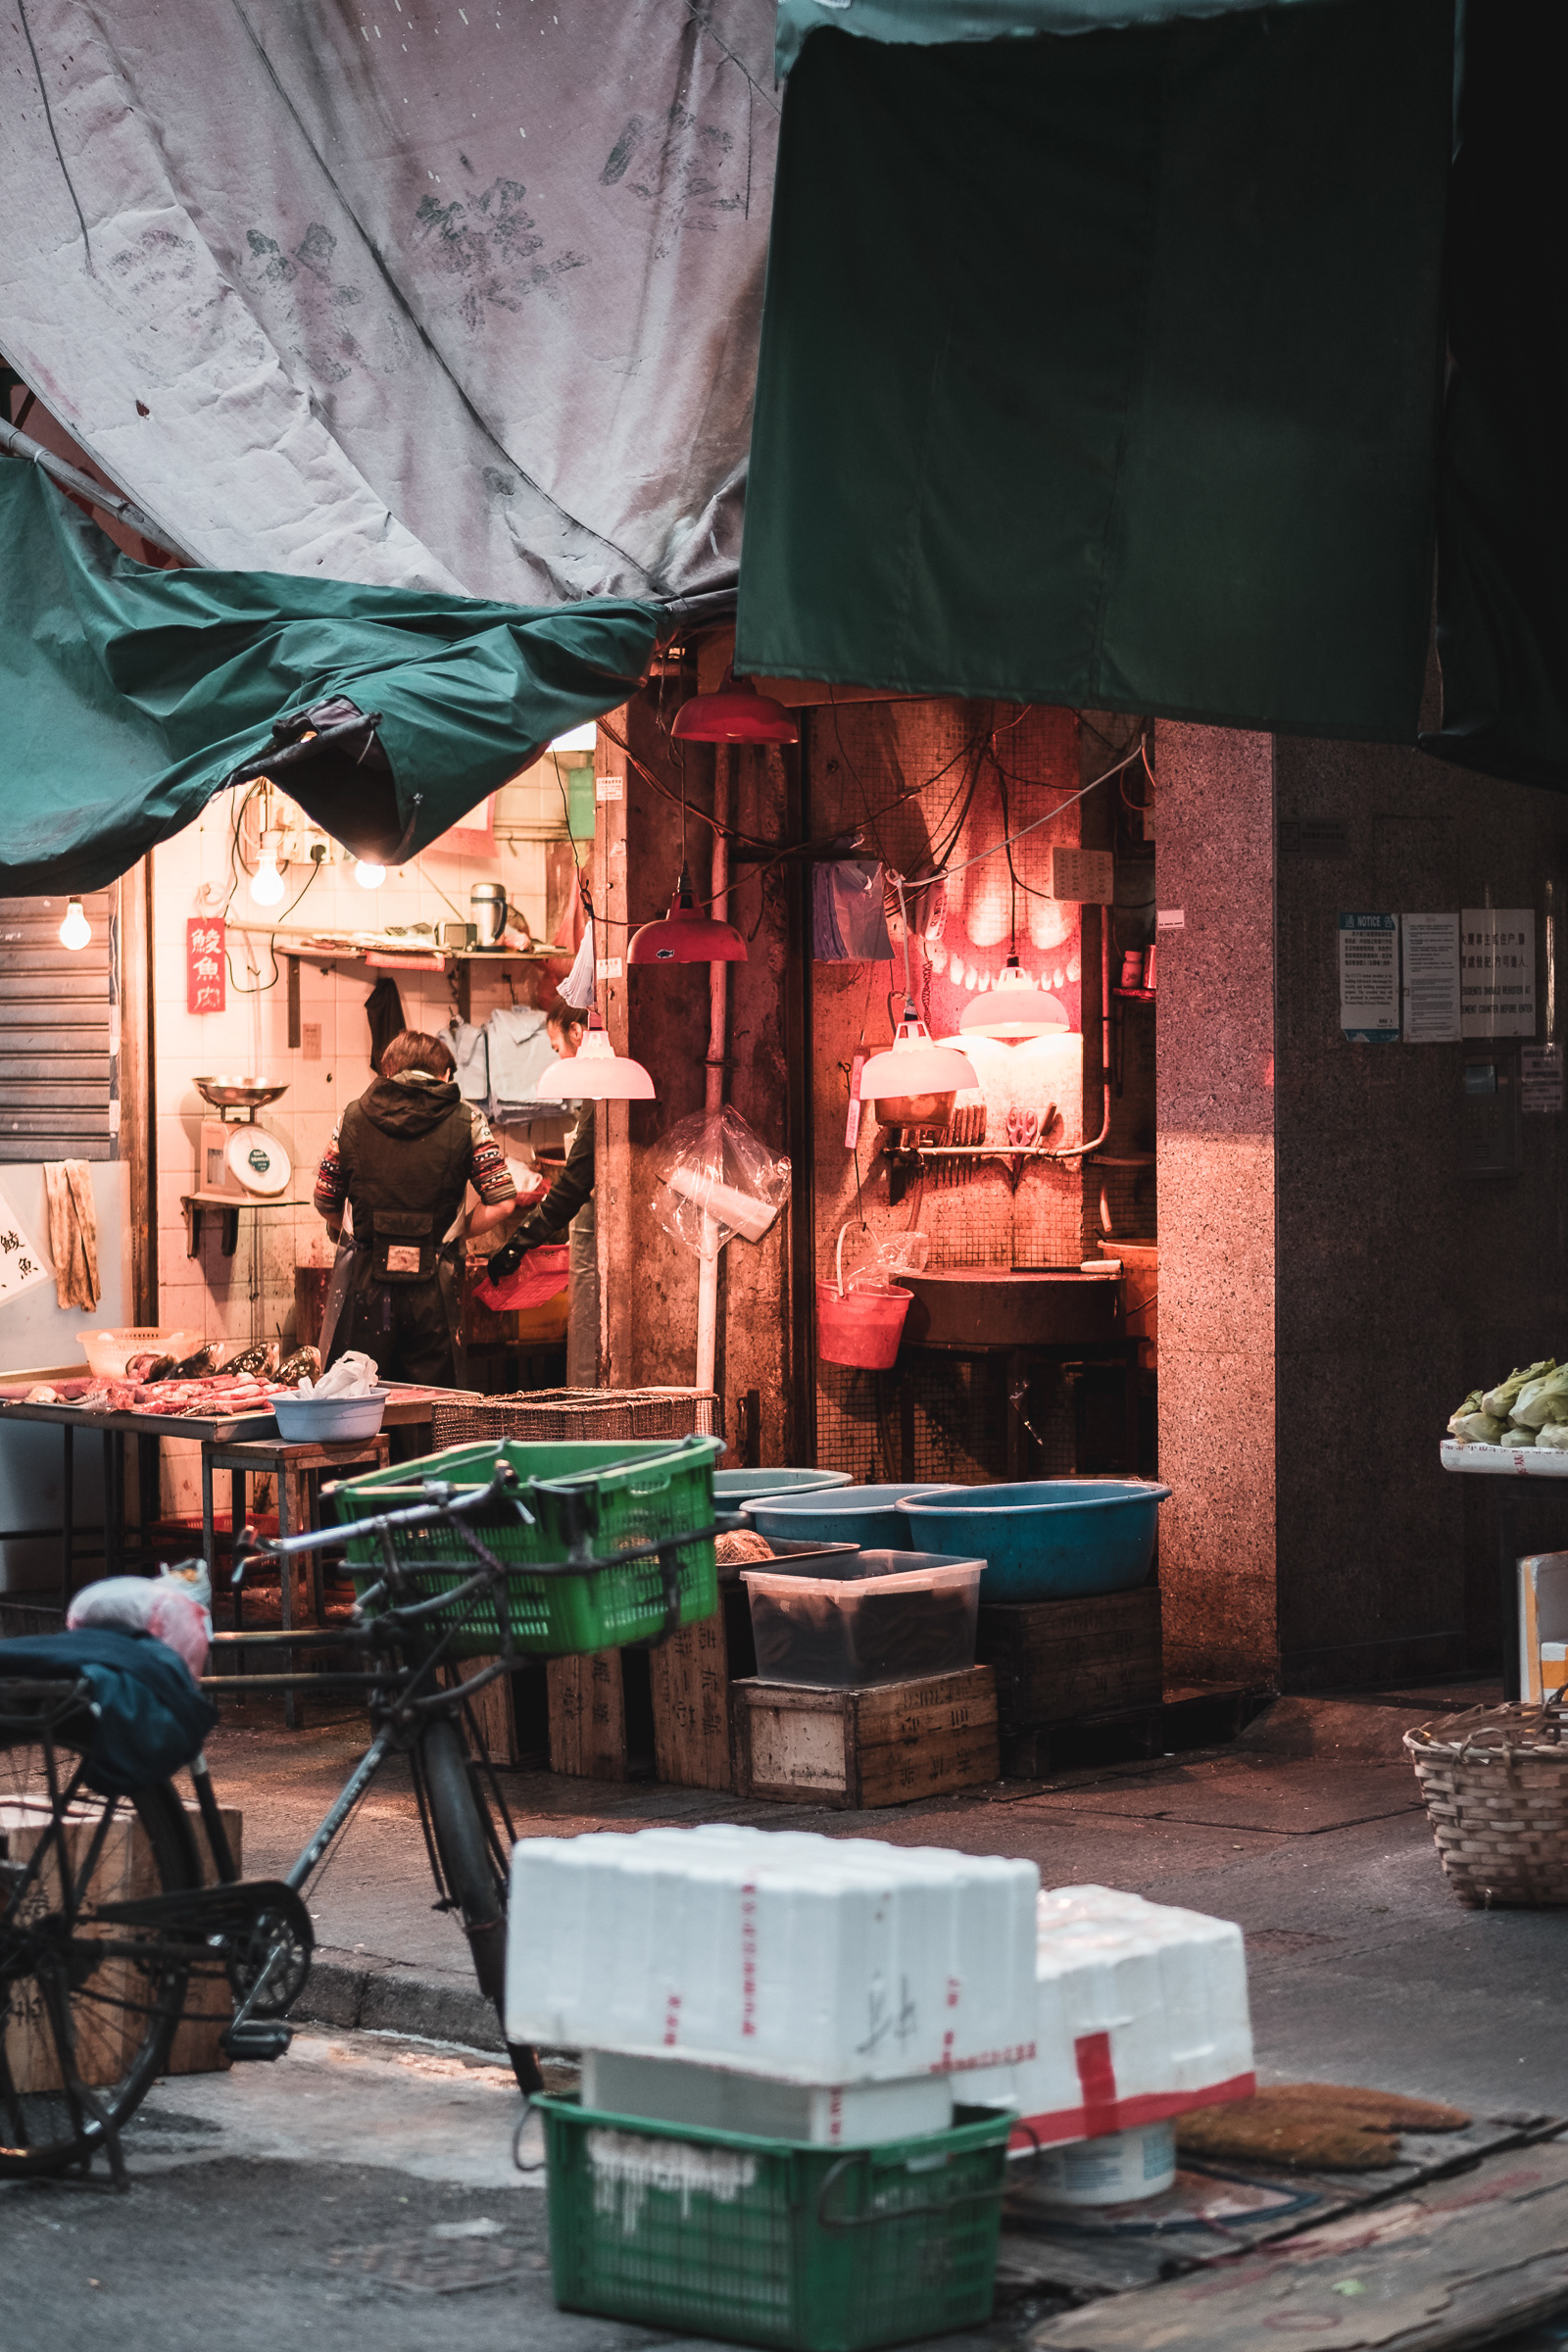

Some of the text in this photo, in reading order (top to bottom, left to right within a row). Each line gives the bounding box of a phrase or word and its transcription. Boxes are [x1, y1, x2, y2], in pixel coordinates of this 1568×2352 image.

[1357, 915, 1381, 927] NOTICE
[191, 928, 222, 1010] 鯪魚肉
